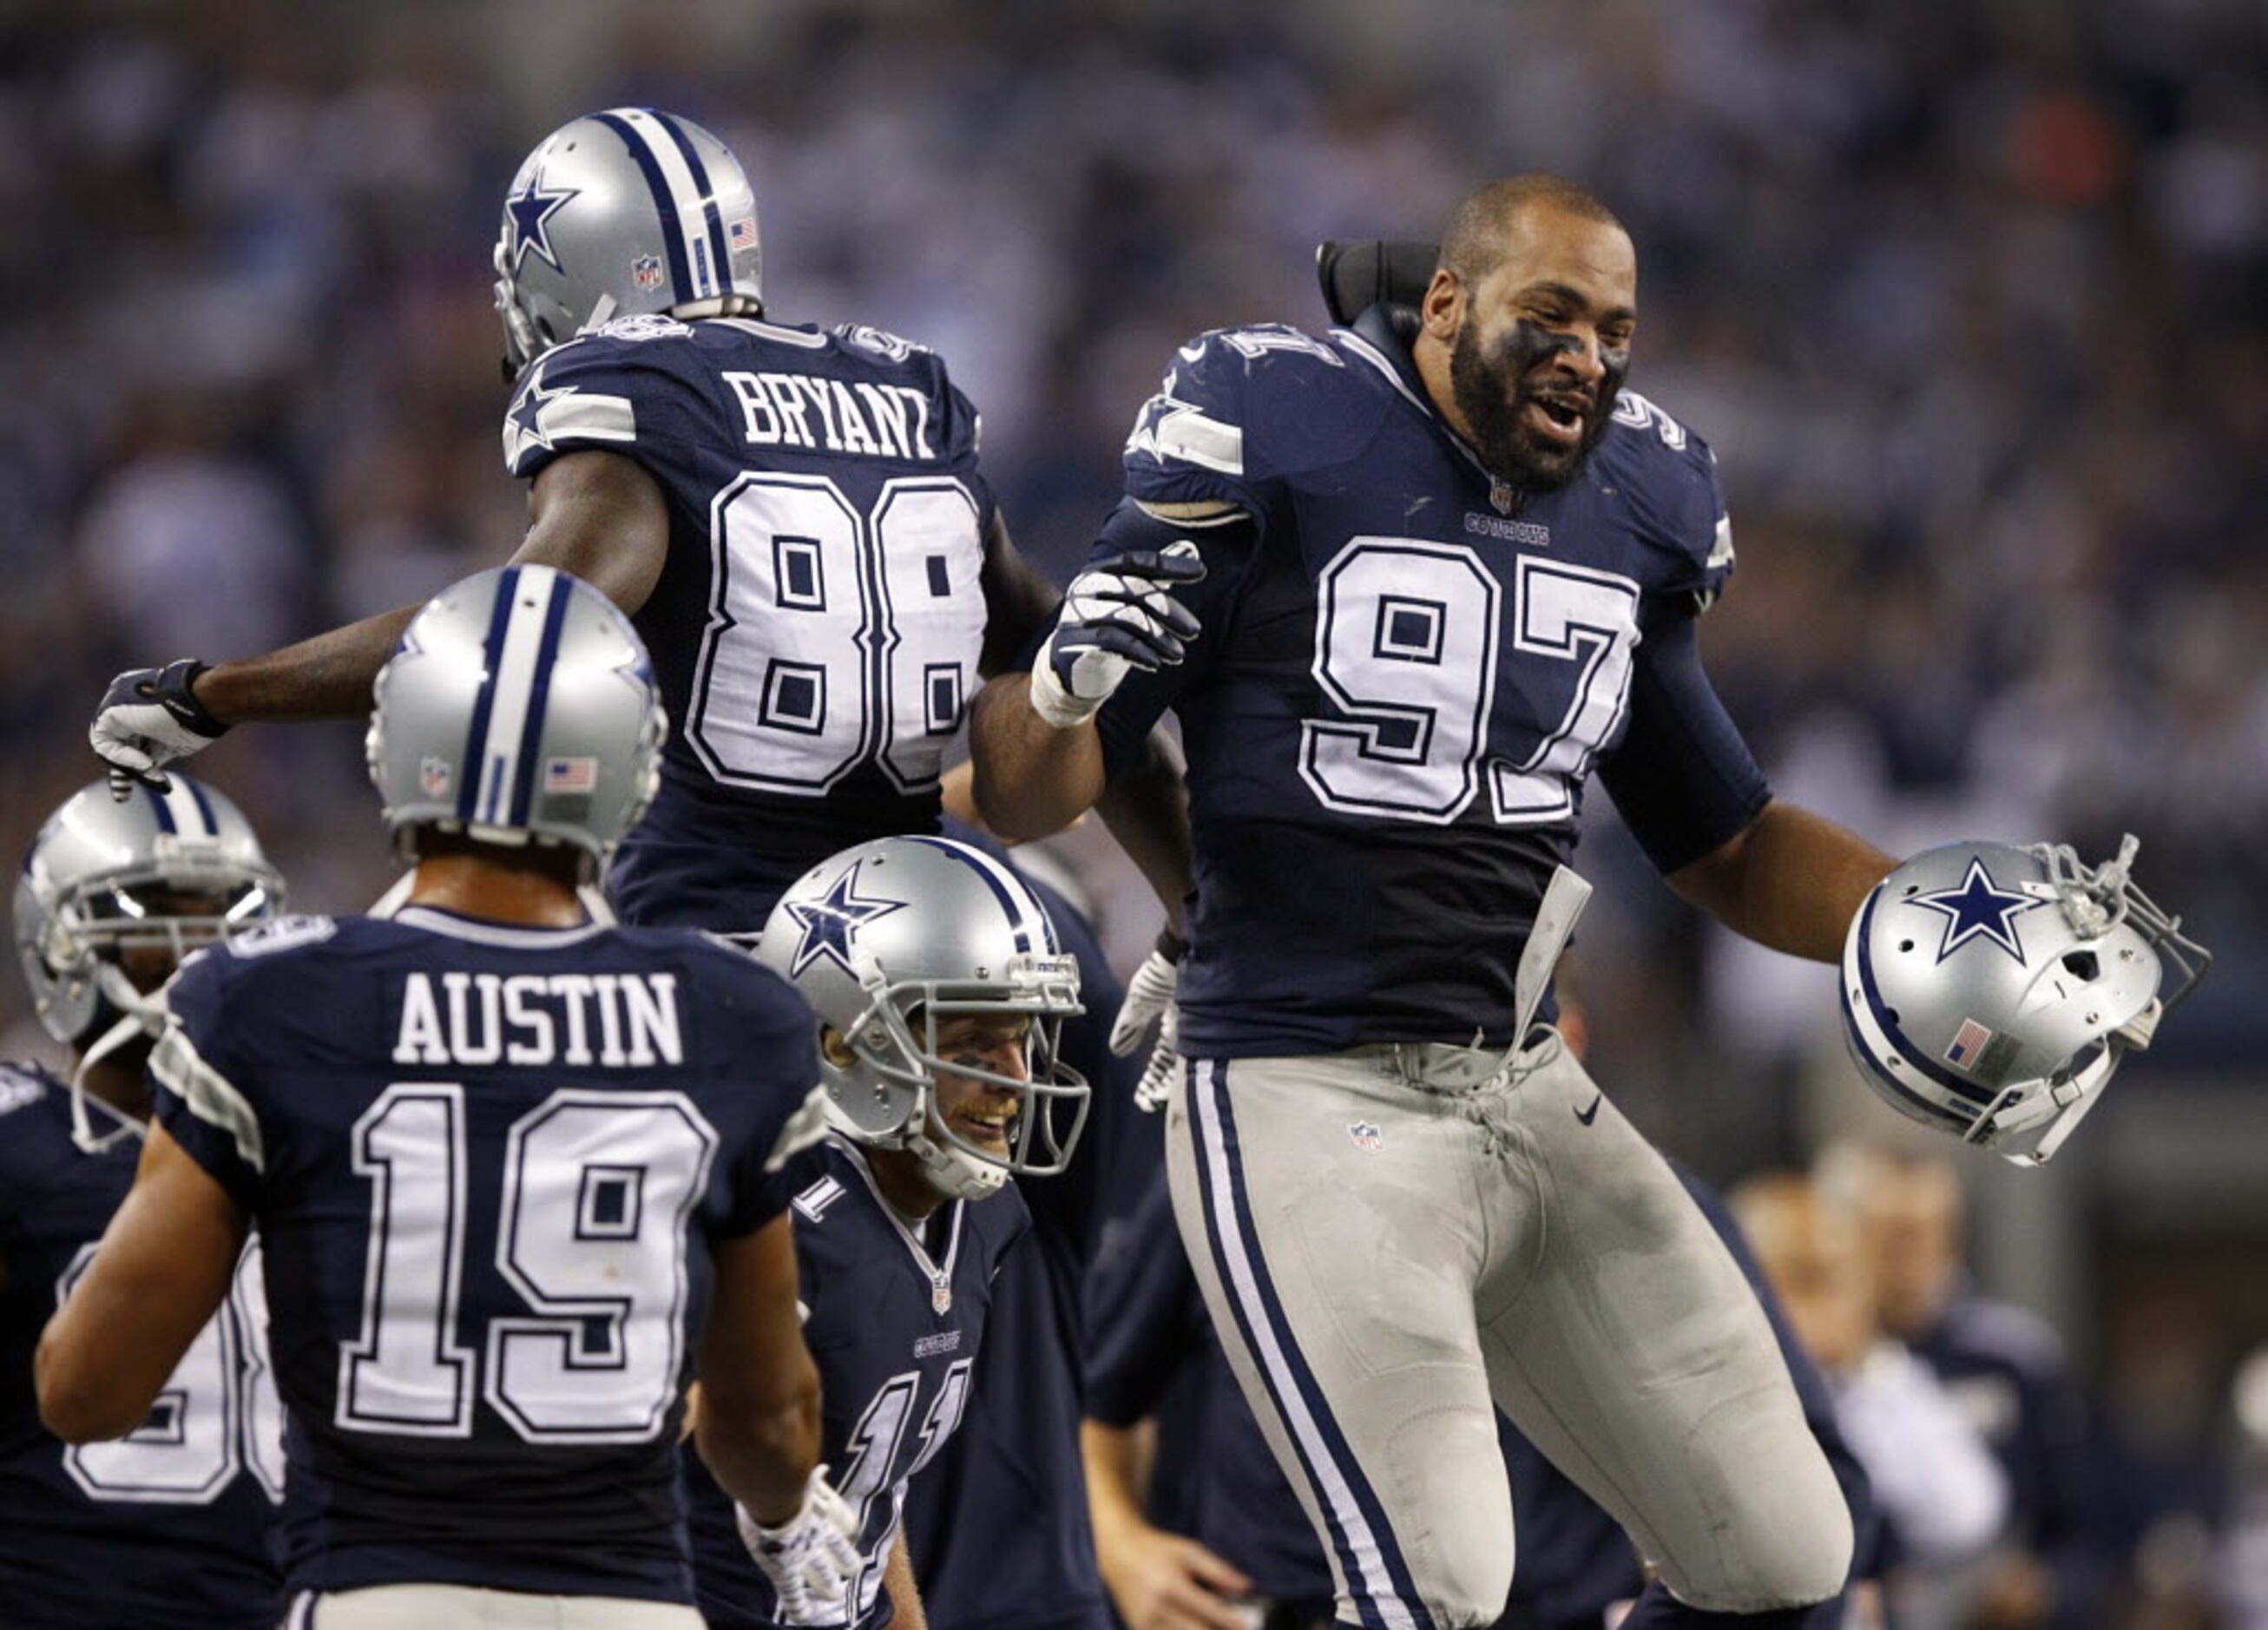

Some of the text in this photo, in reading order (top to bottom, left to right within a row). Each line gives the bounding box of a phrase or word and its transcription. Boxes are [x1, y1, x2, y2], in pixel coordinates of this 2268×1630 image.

[721, 371, 936, 459] BRYANT
[684, 470, 989, 797] 88
[1297, 535, 1642, 825] 97
[392, 971, 683, 1066] AUSTIN
[334, 1082, 720, 1444] 19
